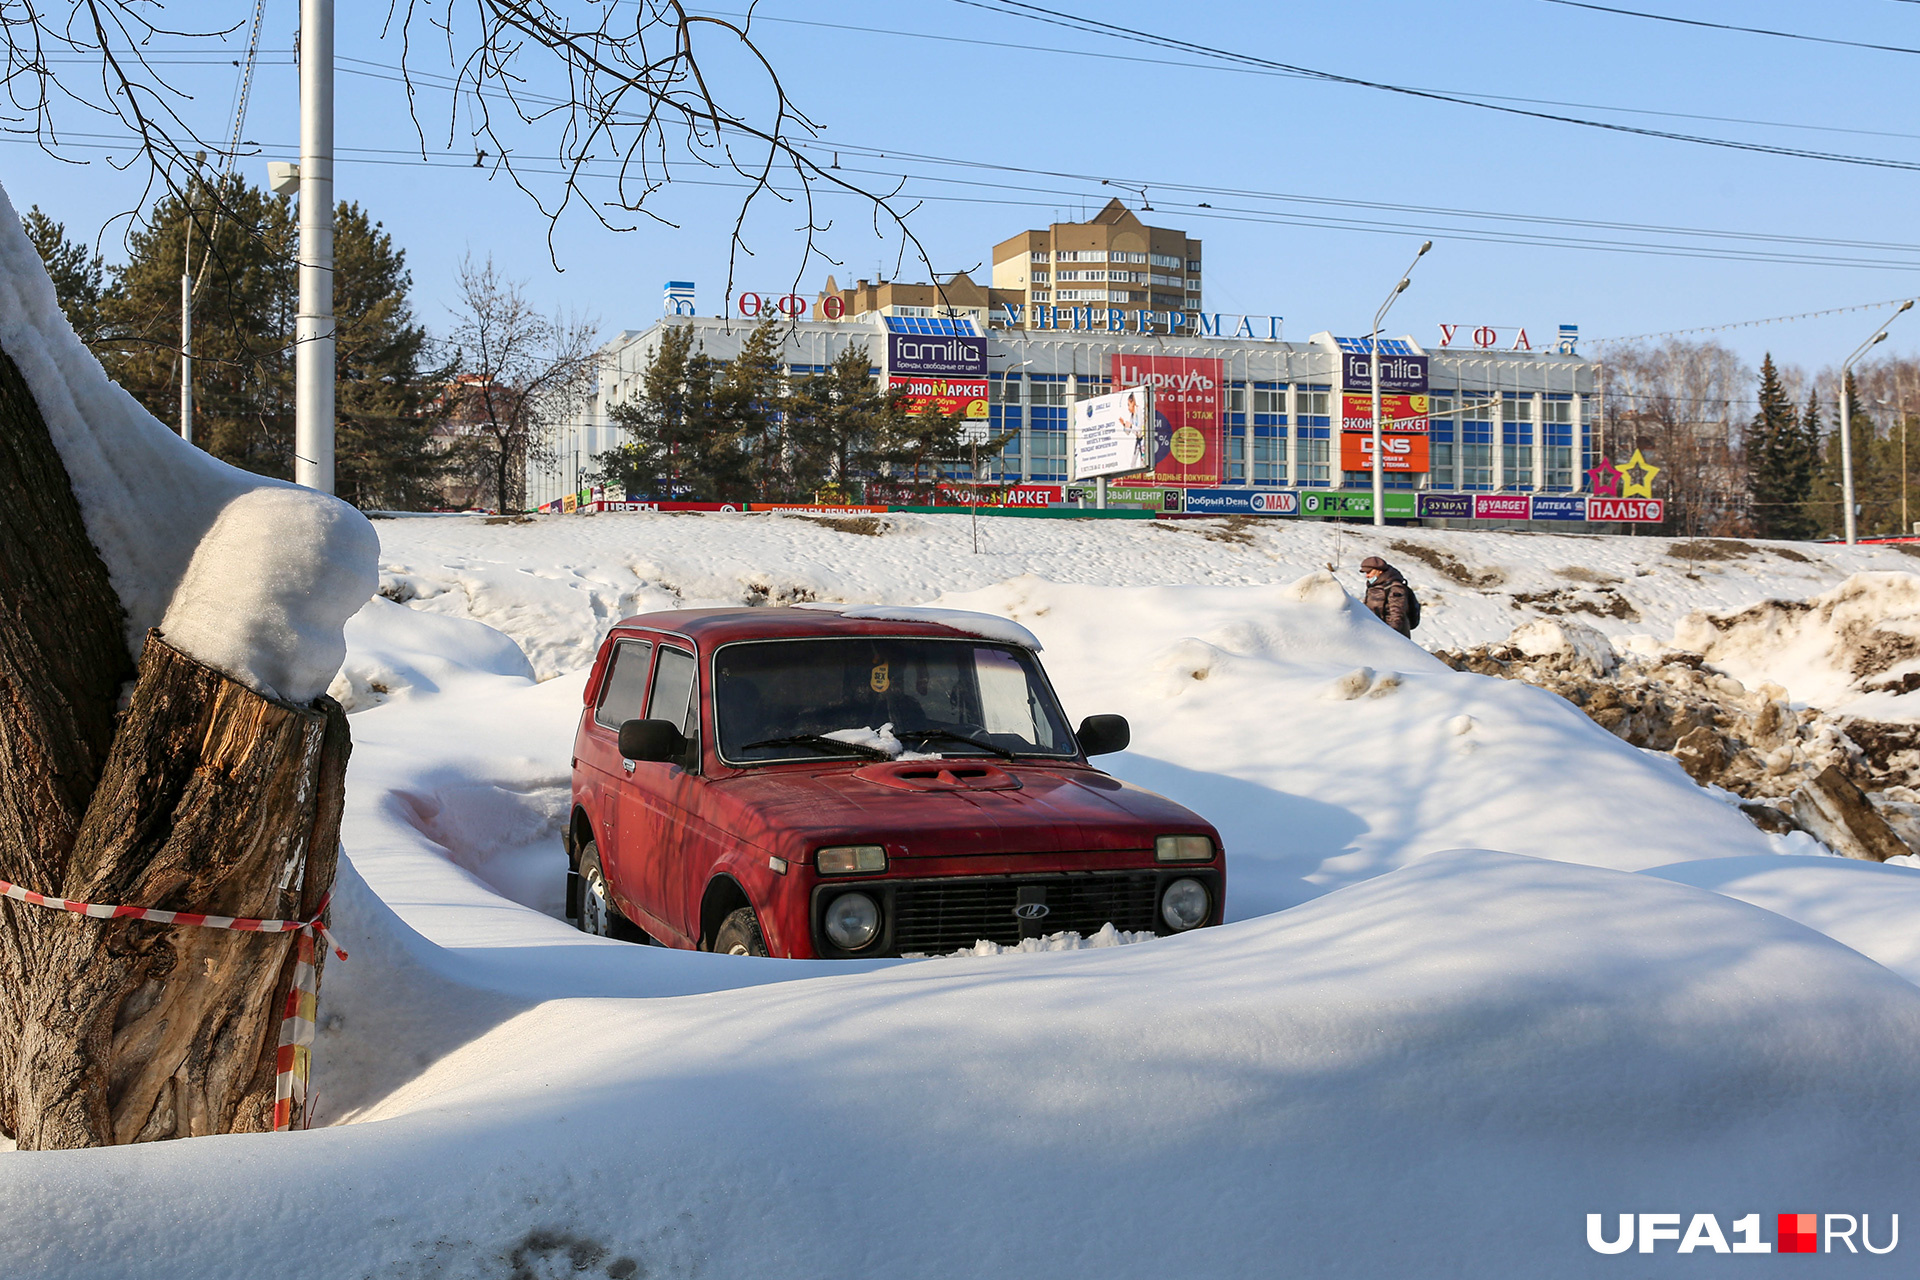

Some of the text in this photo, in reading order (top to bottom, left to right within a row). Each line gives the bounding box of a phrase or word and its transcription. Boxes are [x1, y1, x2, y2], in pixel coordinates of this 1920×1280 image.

[1001, 302, 1283, 340] УНИВЕРМАГ
[1438, 323, 1531, 350] УФА
[897, 337, 980, 361] familia
[923, 362, 956, 370] свободные
[975, 402, 983, 411] 2
[1418, 397, 1425, 406] 2
[1186, 411, 1213, 419] 1 ЭТАЖ
[1343, 415, 1427, 430] ЭКОНМАРКЕТ
[1361, 437, 1411, 453] DNS
[1135, 491, 1161, 503] ЦЕНТР
[1265, 495, 1291, 510] MAX
[1323, 497, 1371, 511] FIX price
[1428, 502, 1468, 510] ЗУМРАТ
